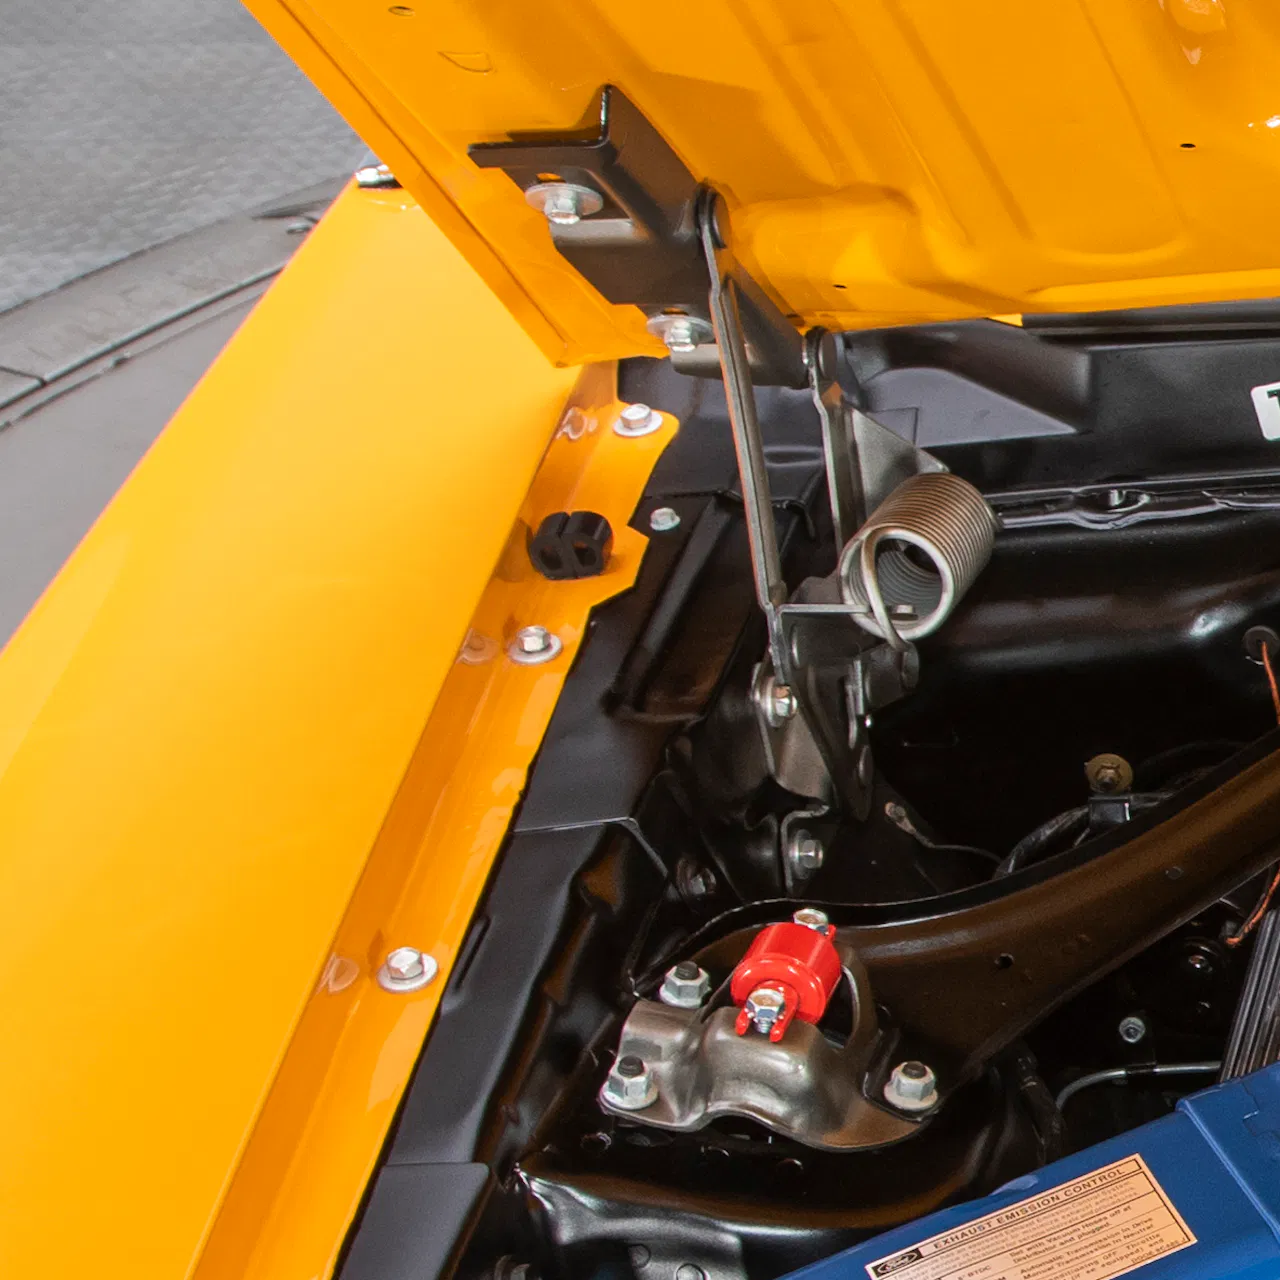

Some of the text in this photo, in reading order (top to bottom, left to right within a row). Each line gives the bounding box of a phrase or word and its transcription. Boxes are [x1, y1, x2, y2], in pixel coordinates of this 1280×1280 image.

[930, 1167, 1125, 1250] EXHAUST EMISSION CONTROL
